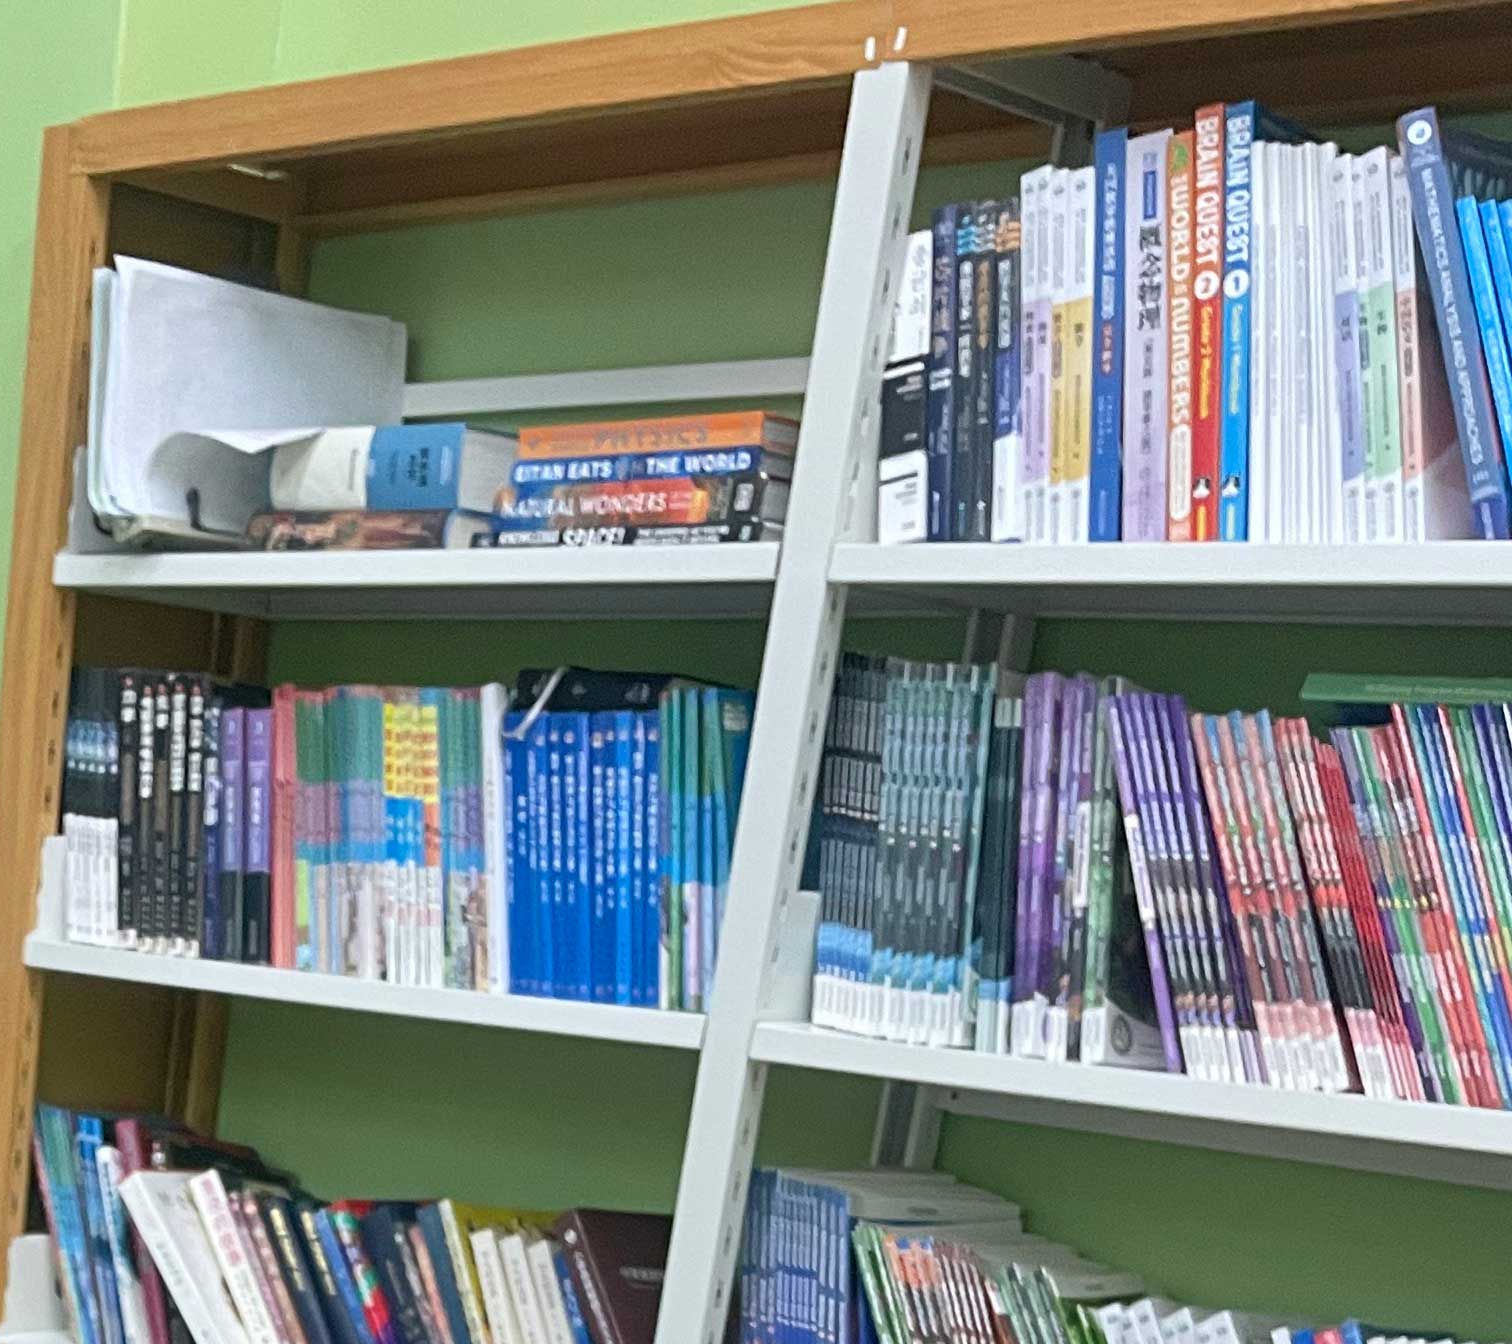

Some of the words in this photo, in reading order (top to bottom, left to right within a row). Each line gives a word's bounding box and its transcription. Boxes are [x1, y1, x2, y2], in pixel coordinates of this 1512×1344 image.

[1195, 116, 1219, 188] BRAIN
[1225, 114, 1251, 187] BRAIN
[1171, 175, 1189, 280] WORLD
[1194, 191, 1219, 264] QUEST
[1224, 189, 1250, 263] QUEST
[1168, 297, 1190, 424] NUMBERS
[567, 458, 613, 480] EATS
[645, 453, 684, 476] THE
[684, 448, 753, 474] WORLD
